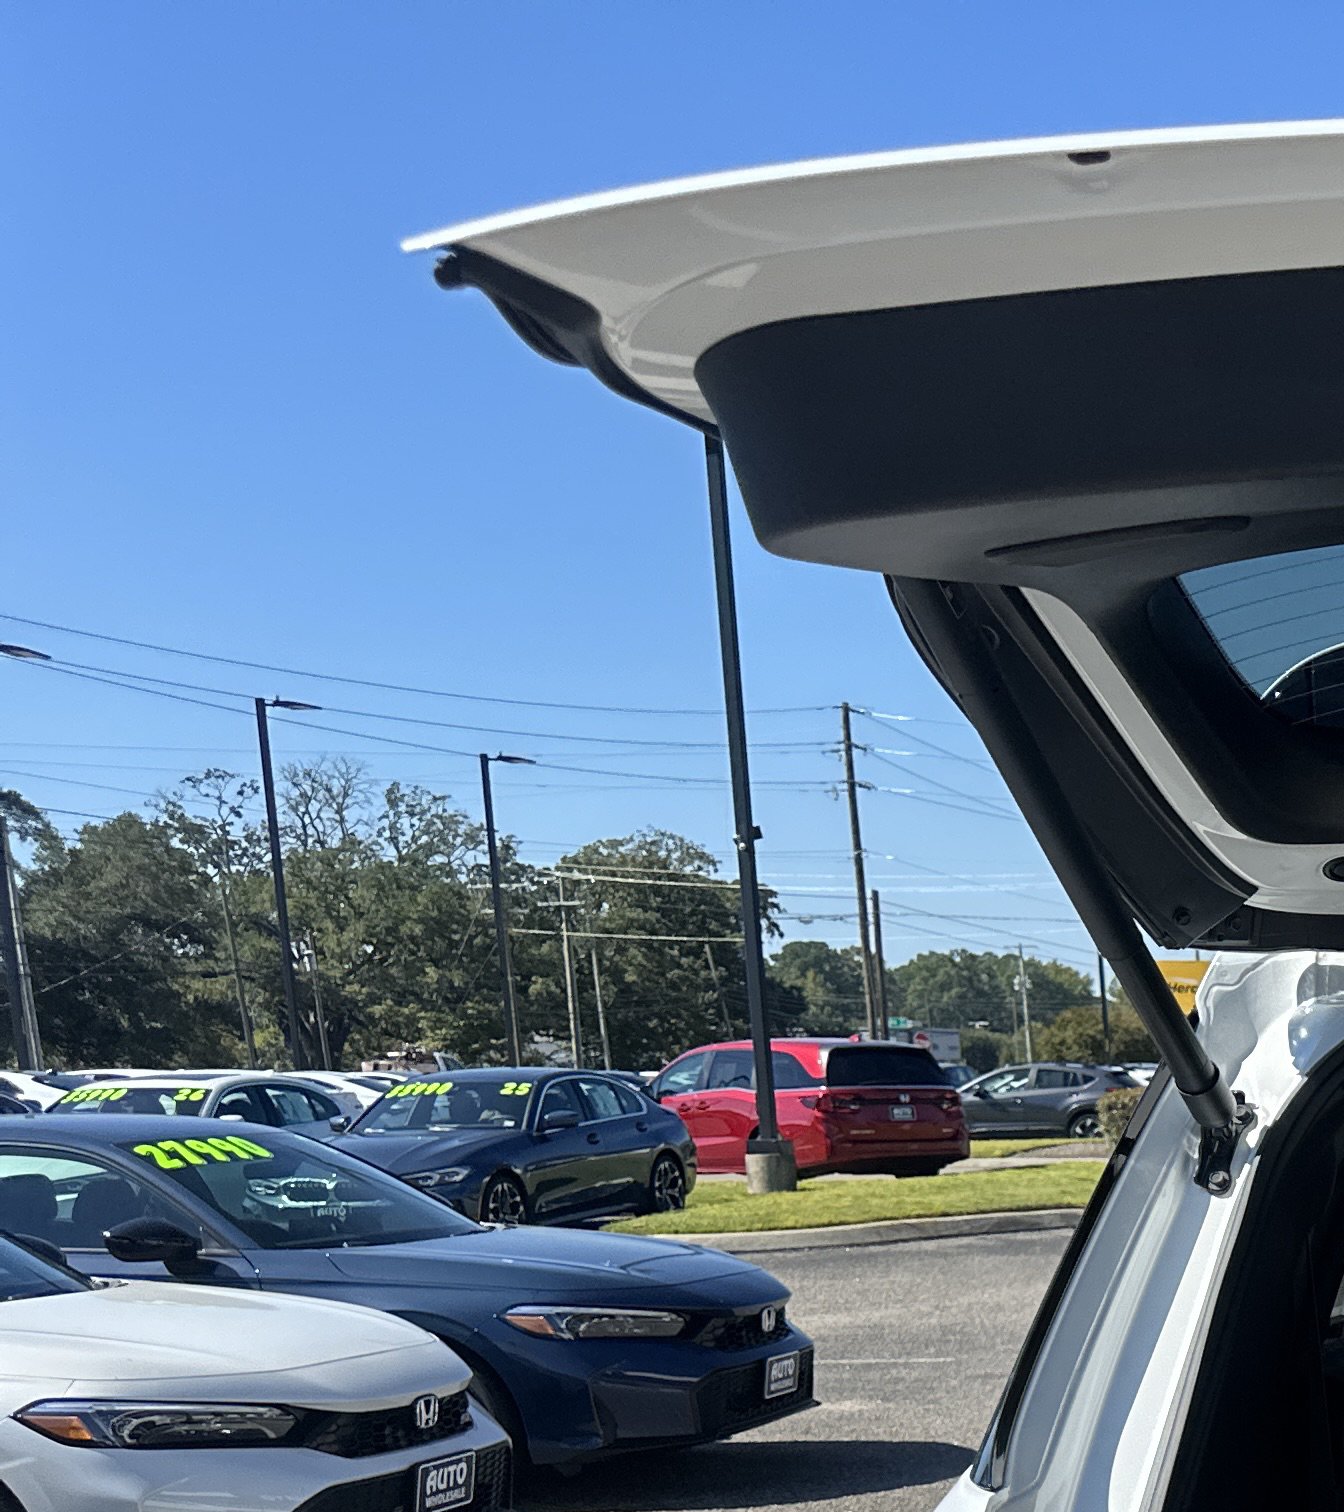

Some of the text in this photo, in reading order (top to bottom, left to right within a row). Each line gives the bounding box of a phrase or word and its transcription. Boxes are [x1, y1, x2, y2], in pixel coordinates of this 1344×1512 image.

[173, 1088, 206, 1101] 26
[500, 1082, 532, 1095] 25
[133, 1136, 274, 1169] 27990
[771, 1358, 795, 1381] AUTO
[426, 1462, 467, 1496] AUTO
